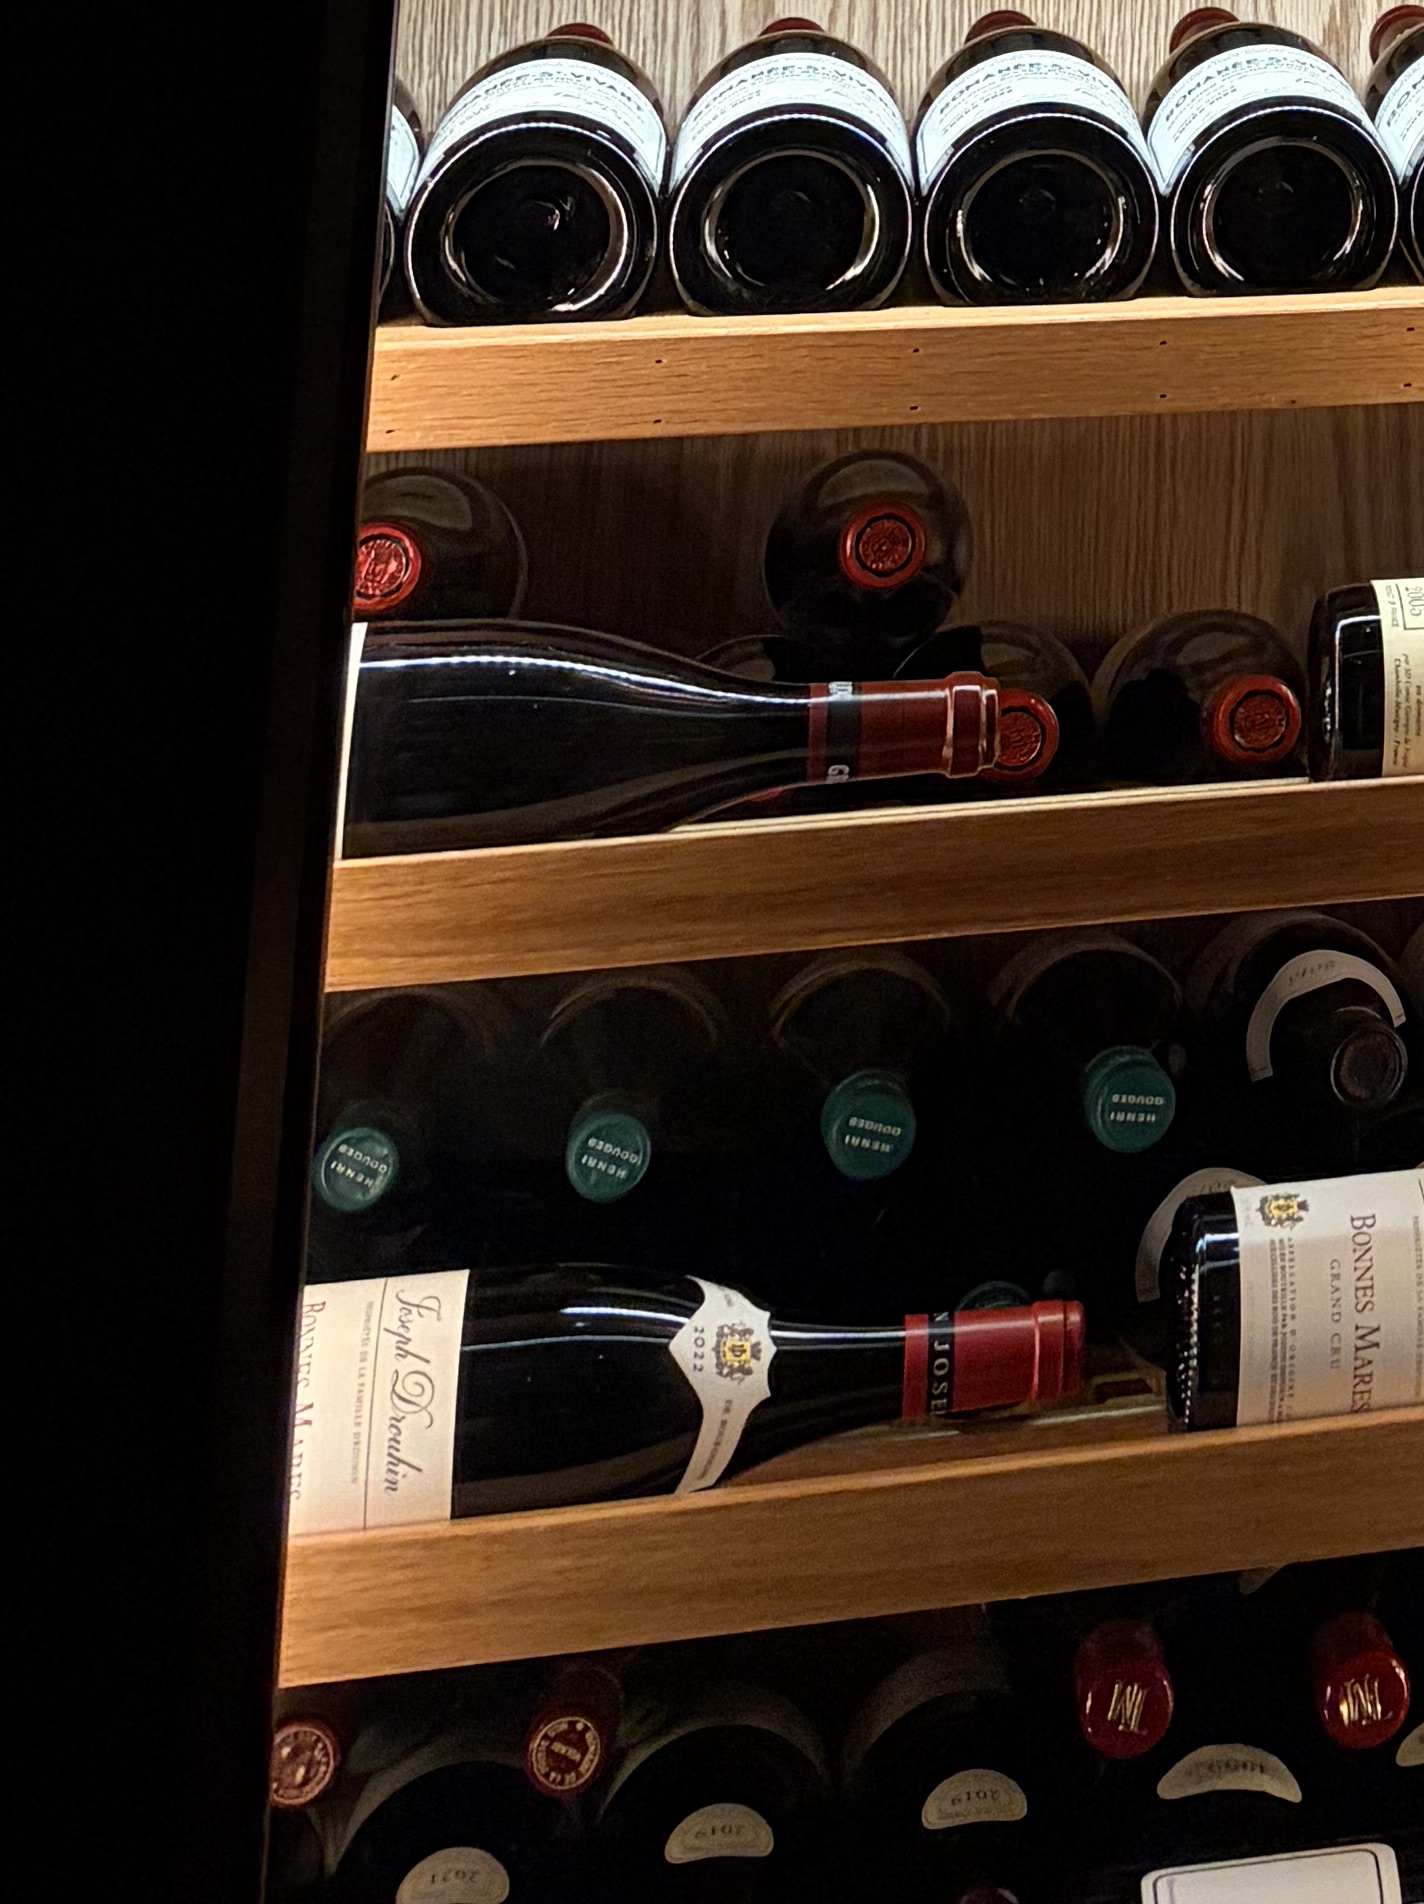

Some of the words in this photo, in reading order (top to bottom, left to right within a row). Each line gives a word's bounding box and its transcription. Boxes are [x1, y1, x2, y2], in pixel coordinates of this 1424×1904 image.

[329, 1160, 375, 1188] HENRI
[581, 1153, 628, 1180] HENRI
[1329, 1259, 1342, 1323] GRAND
[1350, 1213, 1377, 1314] BONNES
[383, 1288, 442, 1365] Joseph
[692, 1326, 705, 1374] 2022
[1329, 1332, 1342, 1371] CRU
[1350, 1322, 1381, 1413] MARES
[384, 1367, 436, 1495] Drouhin
